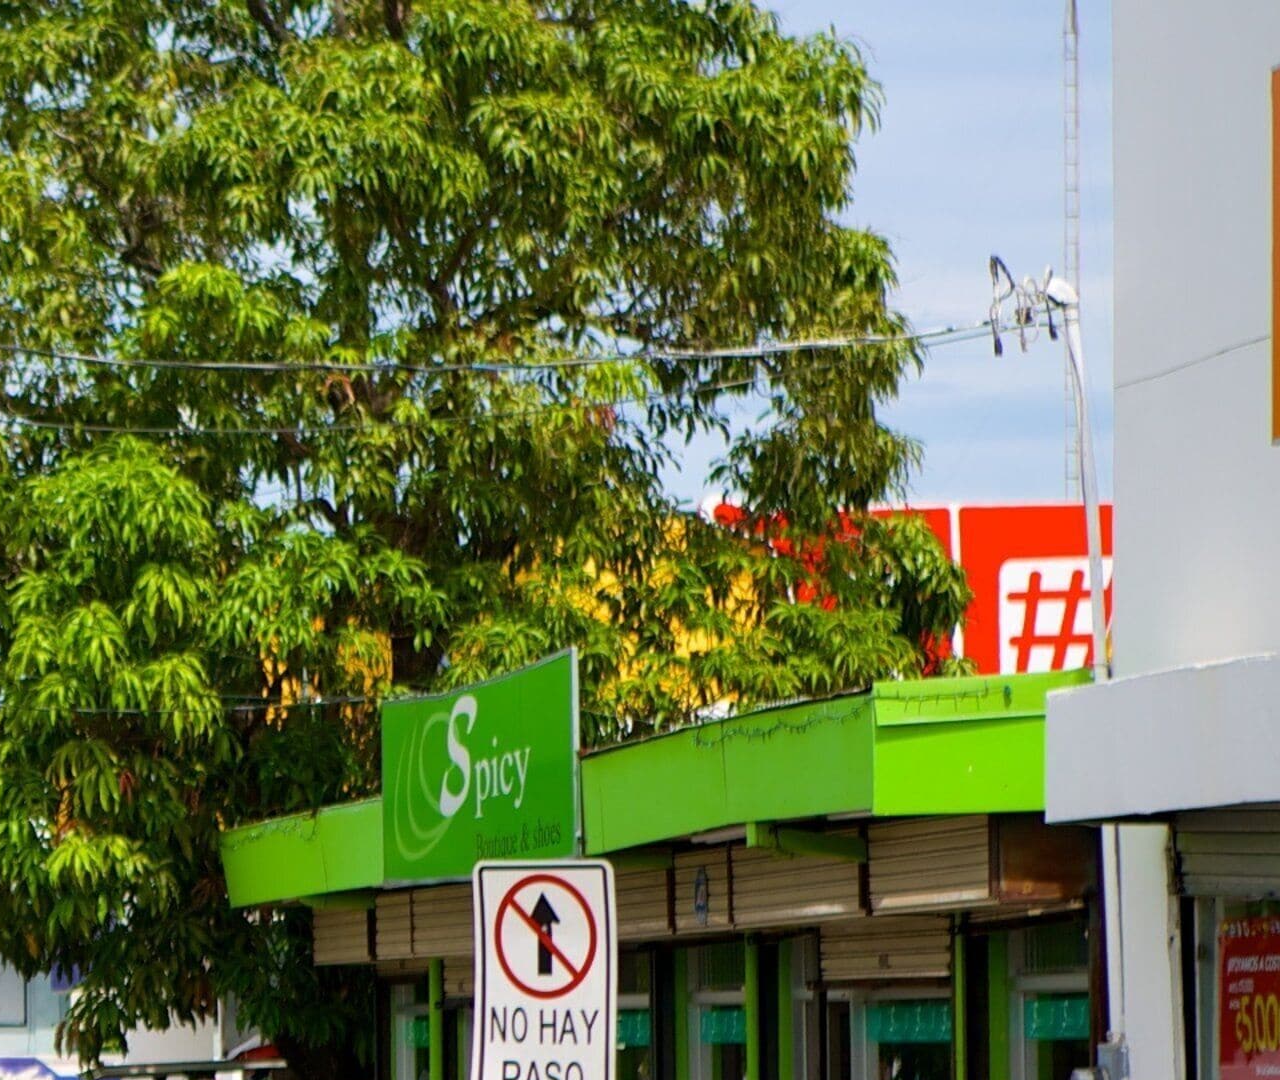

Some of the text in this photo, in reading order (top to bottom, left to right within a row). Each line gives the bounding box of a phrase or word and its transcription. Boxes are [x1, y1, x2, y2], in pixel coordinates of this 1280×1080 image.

[439, 695, 531, 819] Spicy
[490, 1006, 599, 1045] NO HAY
